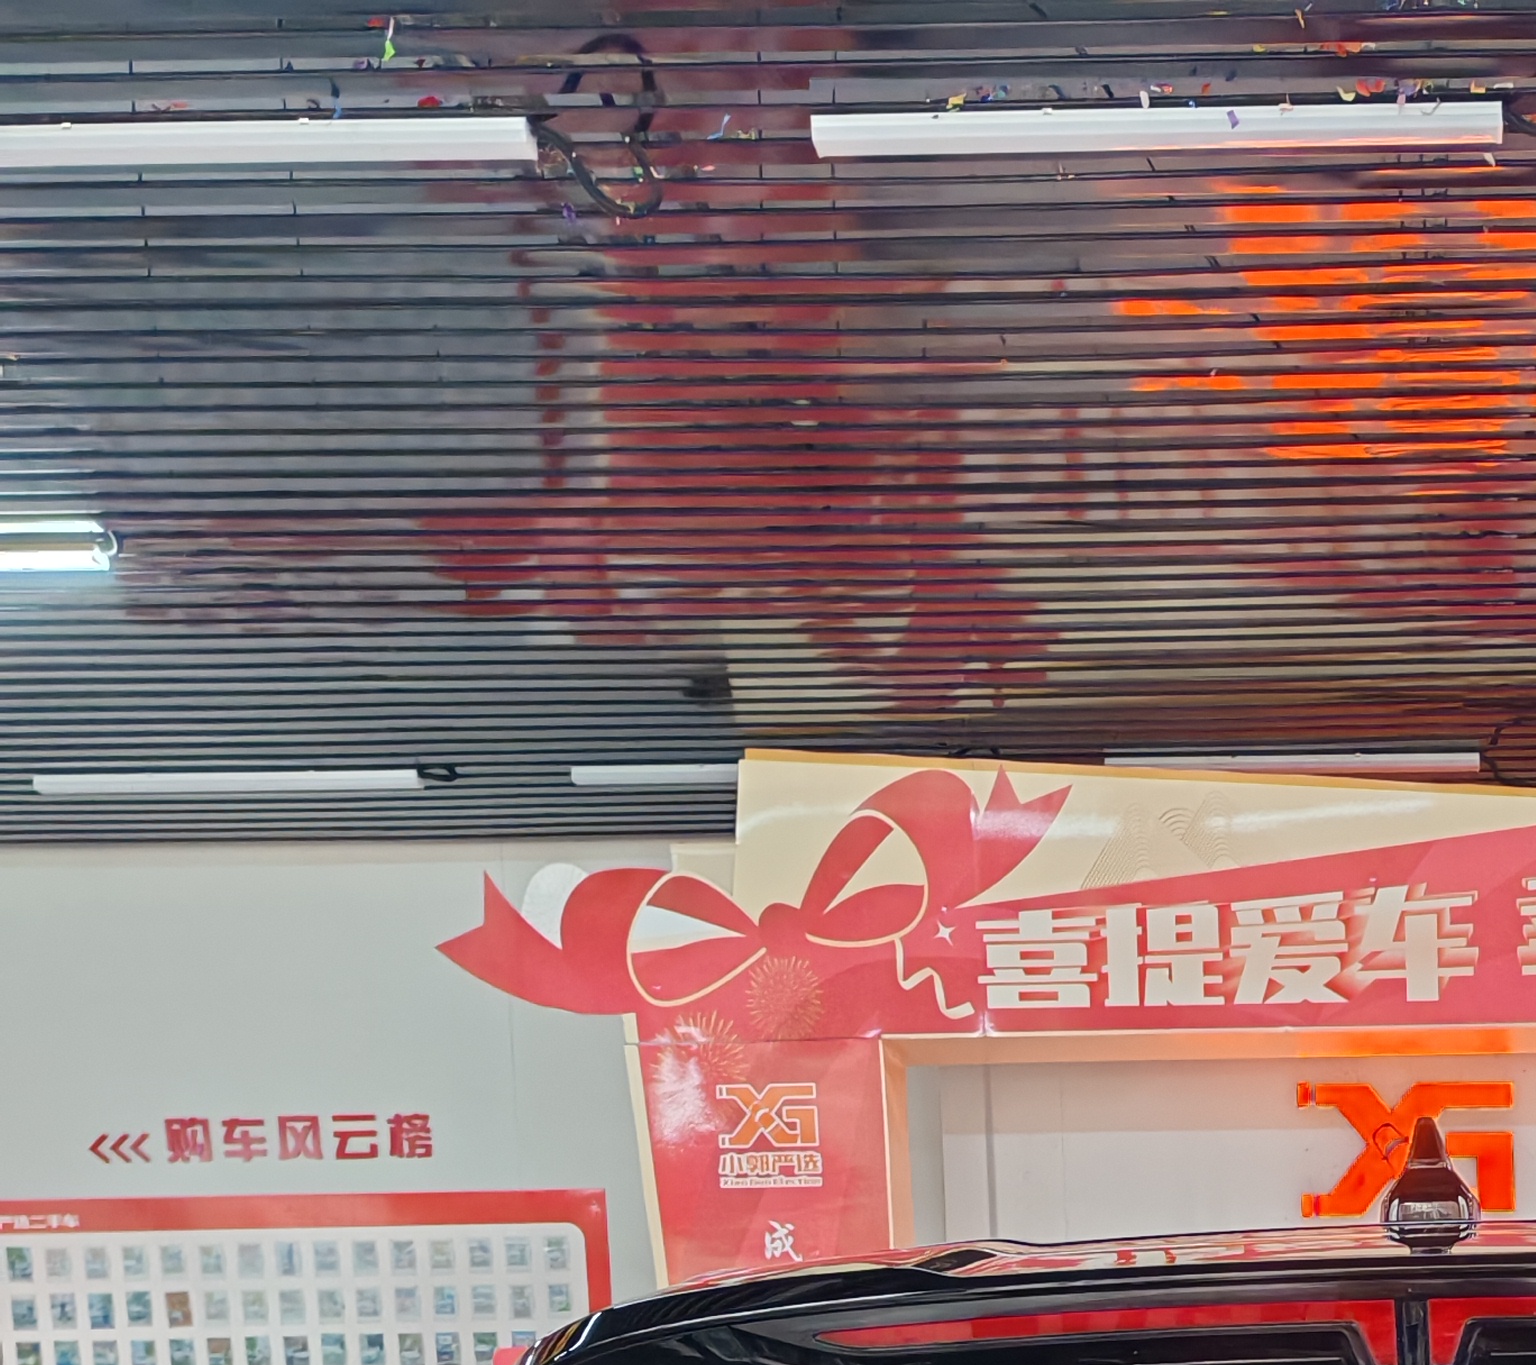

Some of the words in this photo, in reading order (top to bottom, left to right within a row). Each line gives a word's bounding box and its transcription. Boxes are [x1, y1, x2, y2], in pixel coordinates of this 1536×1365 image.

[976, 883, 1478, 1008] 喜提爱车
[164, 1113, 433, 1163] 购车风云榜
